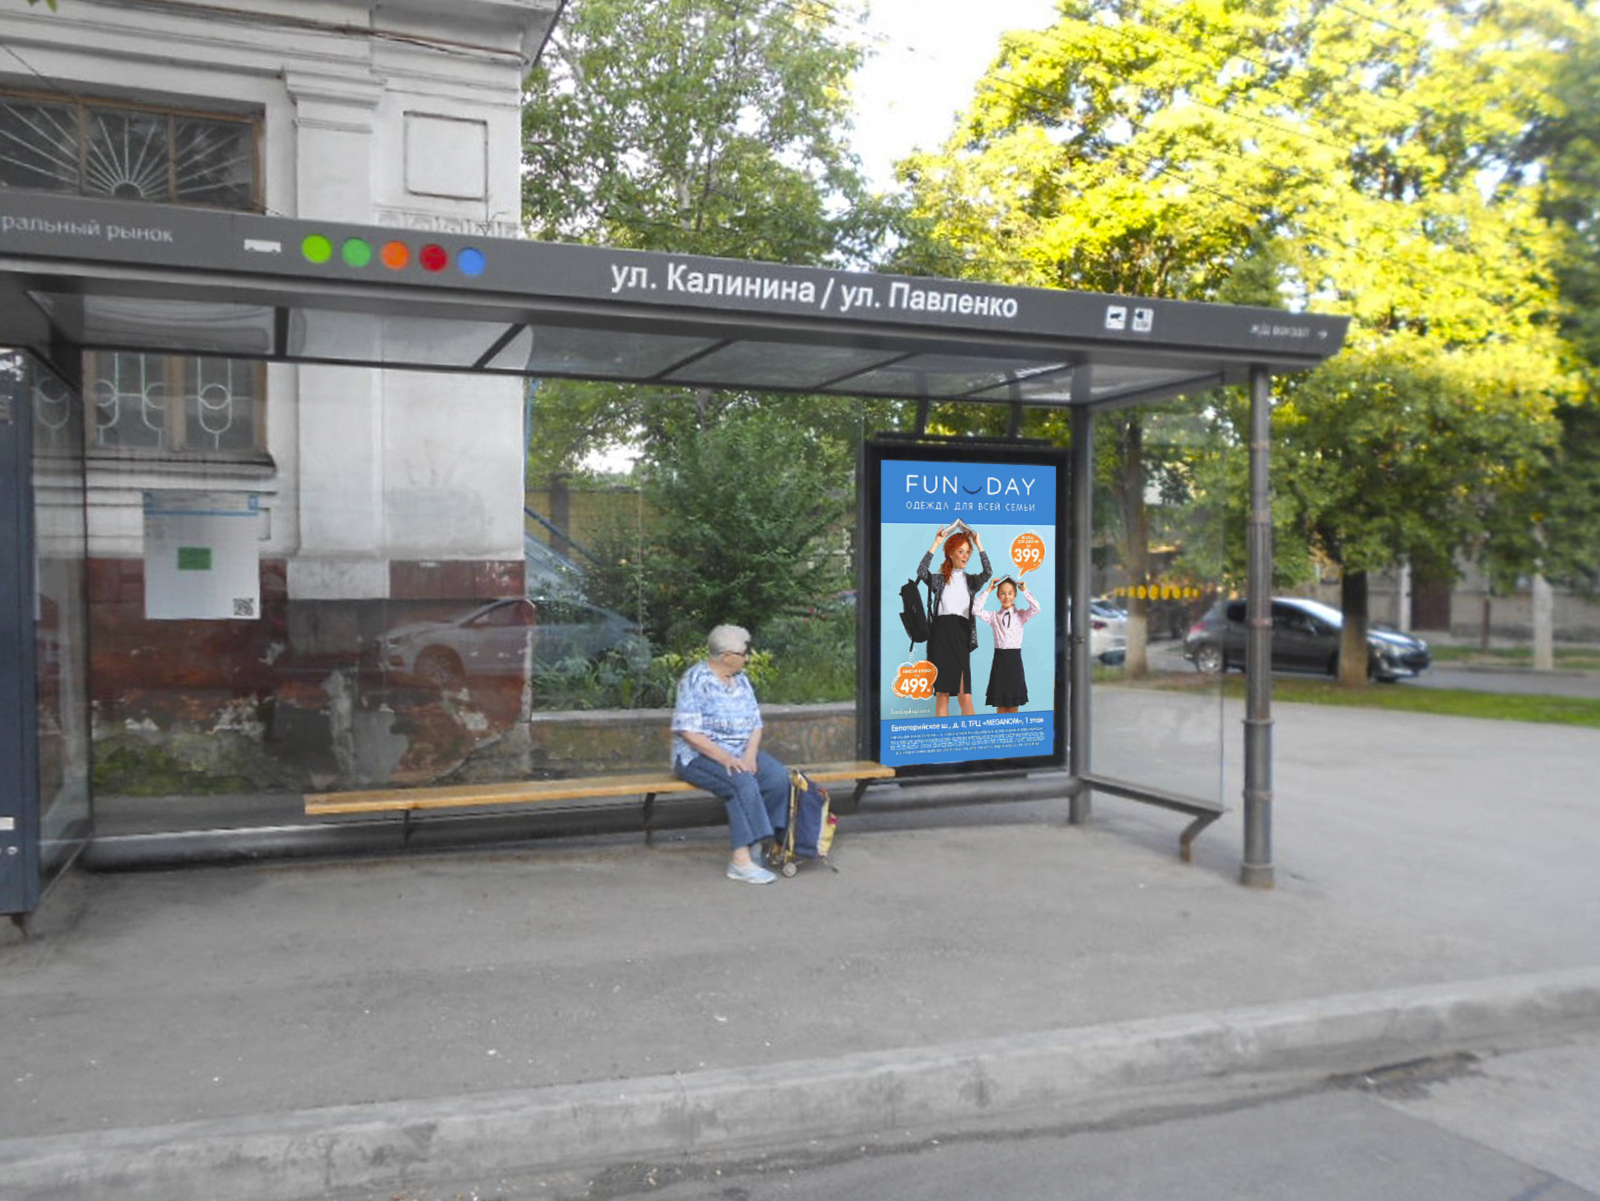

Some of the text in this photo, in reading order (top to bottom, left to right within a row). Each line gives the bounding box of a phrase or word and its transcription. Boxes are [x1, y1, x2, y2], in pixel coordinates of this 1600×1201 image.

[106, 224, 174, 242] рынок
[610, 263, 657, 294] ул.
[667, 262, 816, 304] Калинина
[839, 284, 881, 312] ул.
[889, 281, 1018, 318] Павленко
[906, 474, 1036, 497] FUN DAY
[905, 500, 1036, 512] ОДЕЖДА ДЛЯ ВСЕЙ СЕМЬИ
